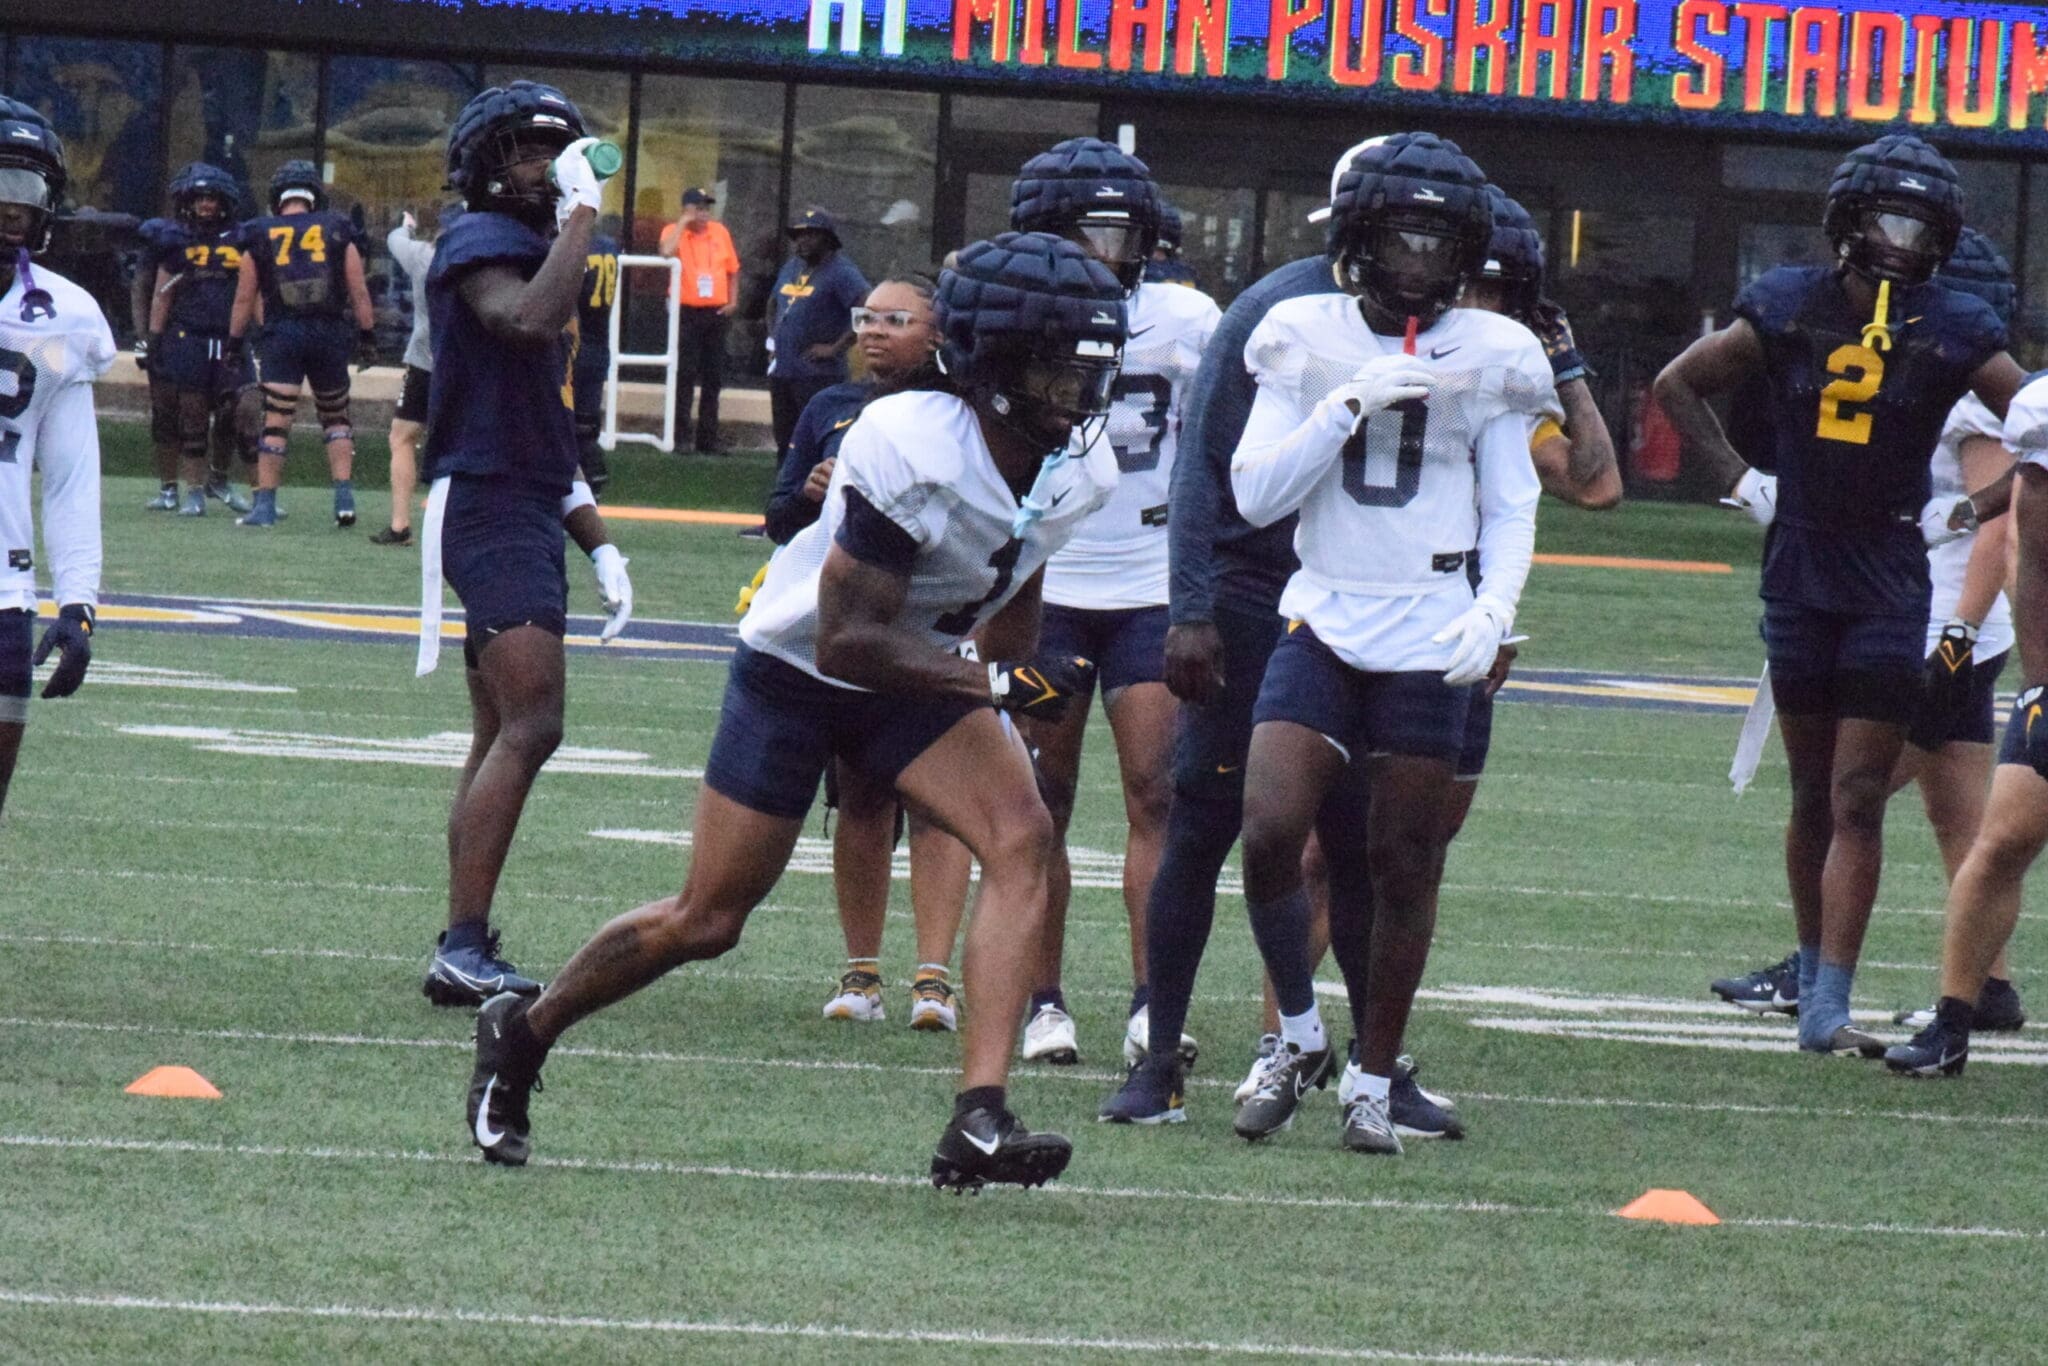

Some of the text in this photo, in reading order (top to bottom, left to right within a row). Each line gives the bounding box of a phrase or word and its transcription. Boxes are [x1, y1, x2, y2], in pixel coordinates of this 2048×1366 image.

[952, 0, 1229, 77] MILAN
[1266, 0, 1633, 103] PUSKAR
[1671, 0, 2048, 130] STADIUM
[268, 224, 326, 266] 74
[1816, 343, 1885, 445] 2
[1342, 395, 1429, 508] 0
